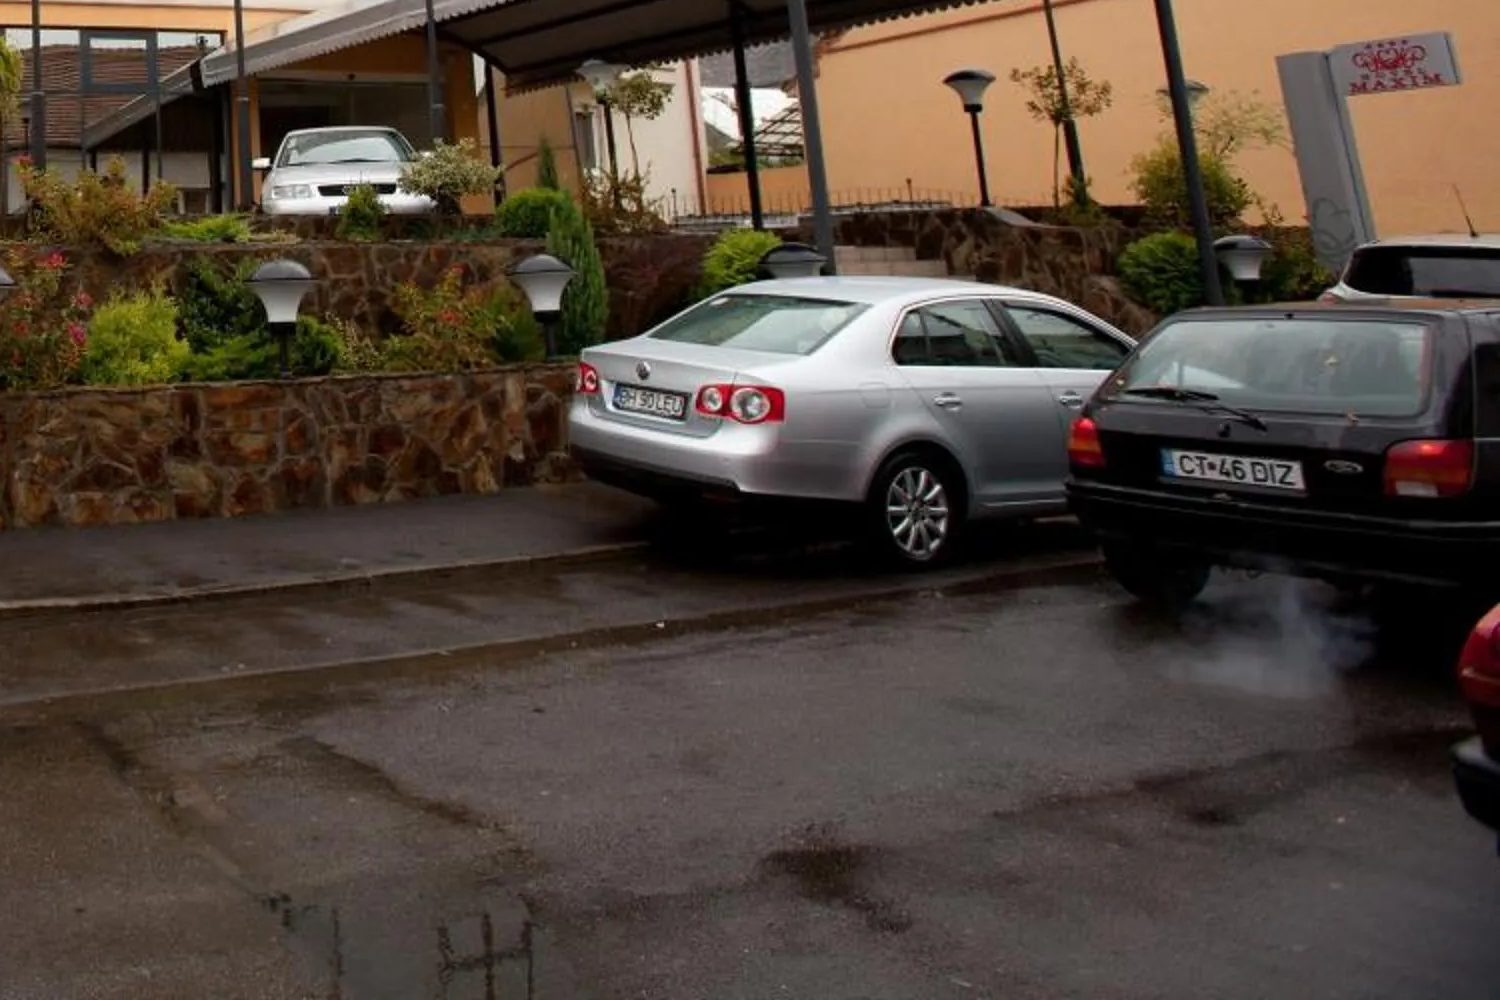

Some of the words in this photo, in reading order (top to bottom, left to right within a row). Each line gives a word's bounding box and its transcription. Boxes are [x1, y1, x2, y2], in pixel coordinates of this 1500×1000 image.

[1348, 72, 1445, 95] MAXIM
[1178, 454, 1208, 476] CT
[1219, 459, 1247, 481] 46
[1251, 461, 1296, 486] DIZ
